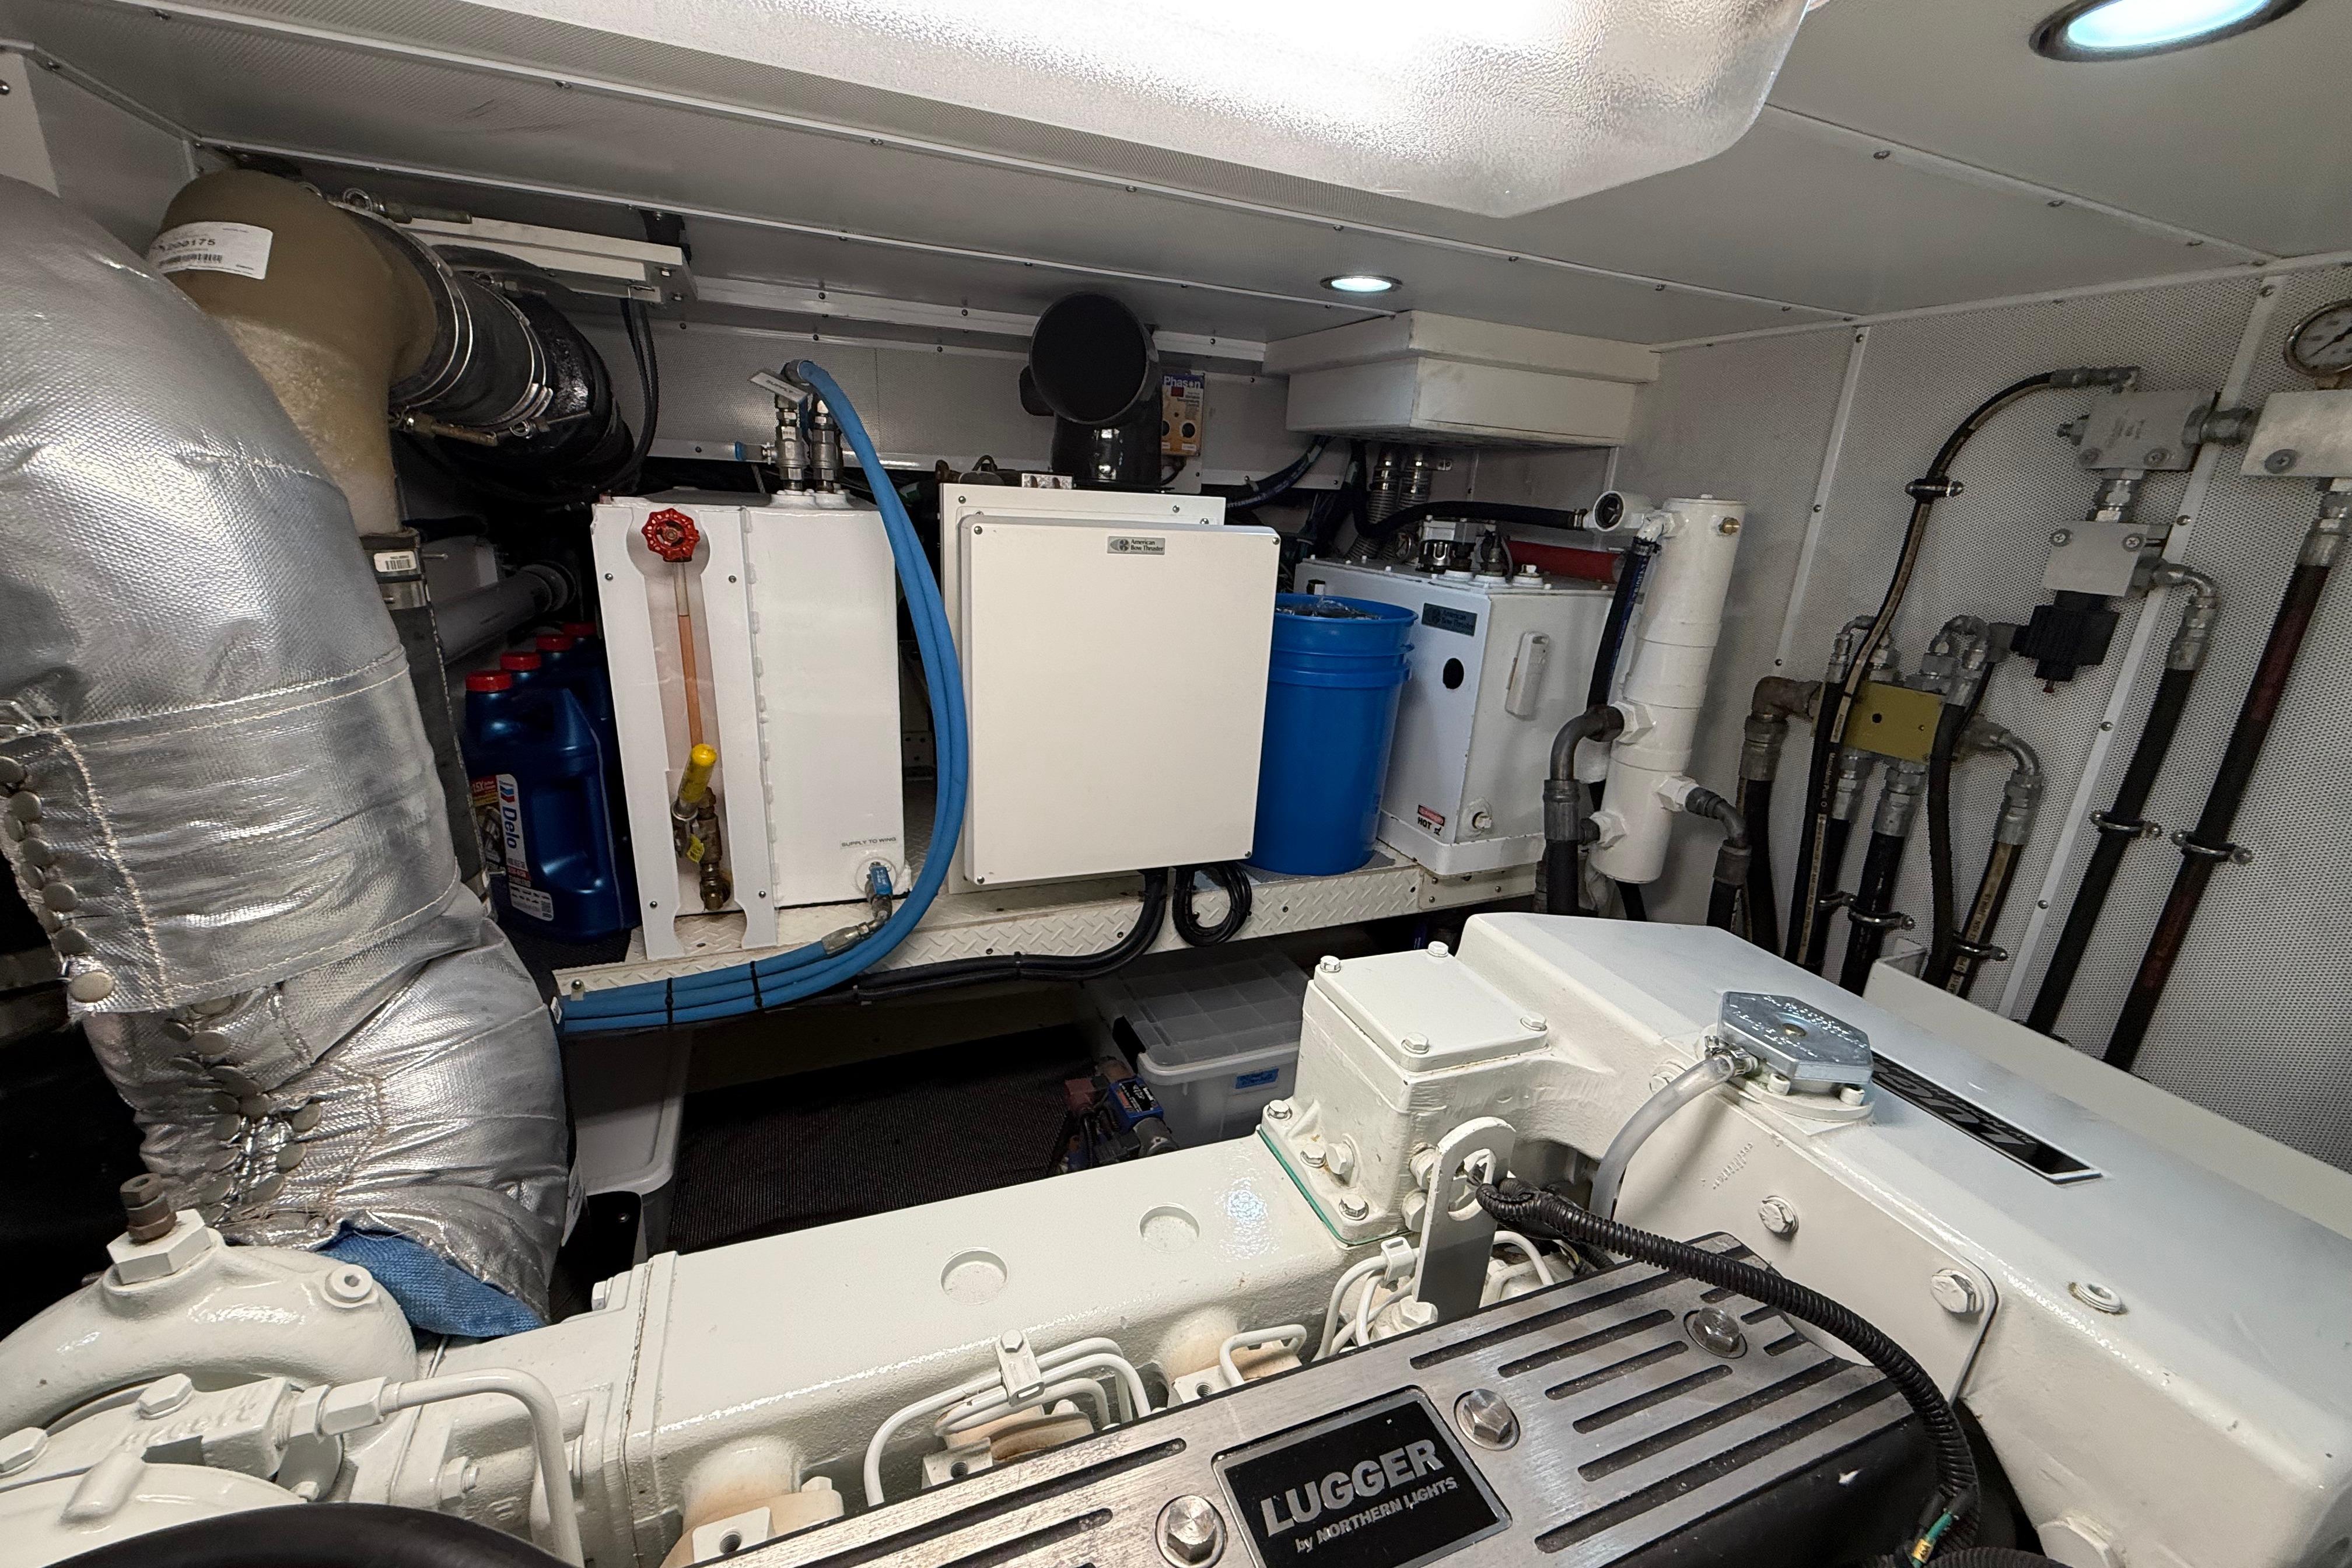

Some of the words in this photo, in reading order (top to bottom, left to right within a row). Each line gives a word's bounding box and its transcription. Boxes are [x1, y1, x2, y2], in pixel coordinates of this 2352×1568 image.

[1164, 376, 1200, 389] Phason
[503, 806, 520, 849] Delo
[1418, 817, 1432, 830] HOT
[1260, 1439, 1444, 1538] LUGGER
[1295, 1536, 1314, 1553] by
[1316, 1496, 1401, 1545] NORTHERN
[1404, 1476, 1458, 1509] LIGHTS
